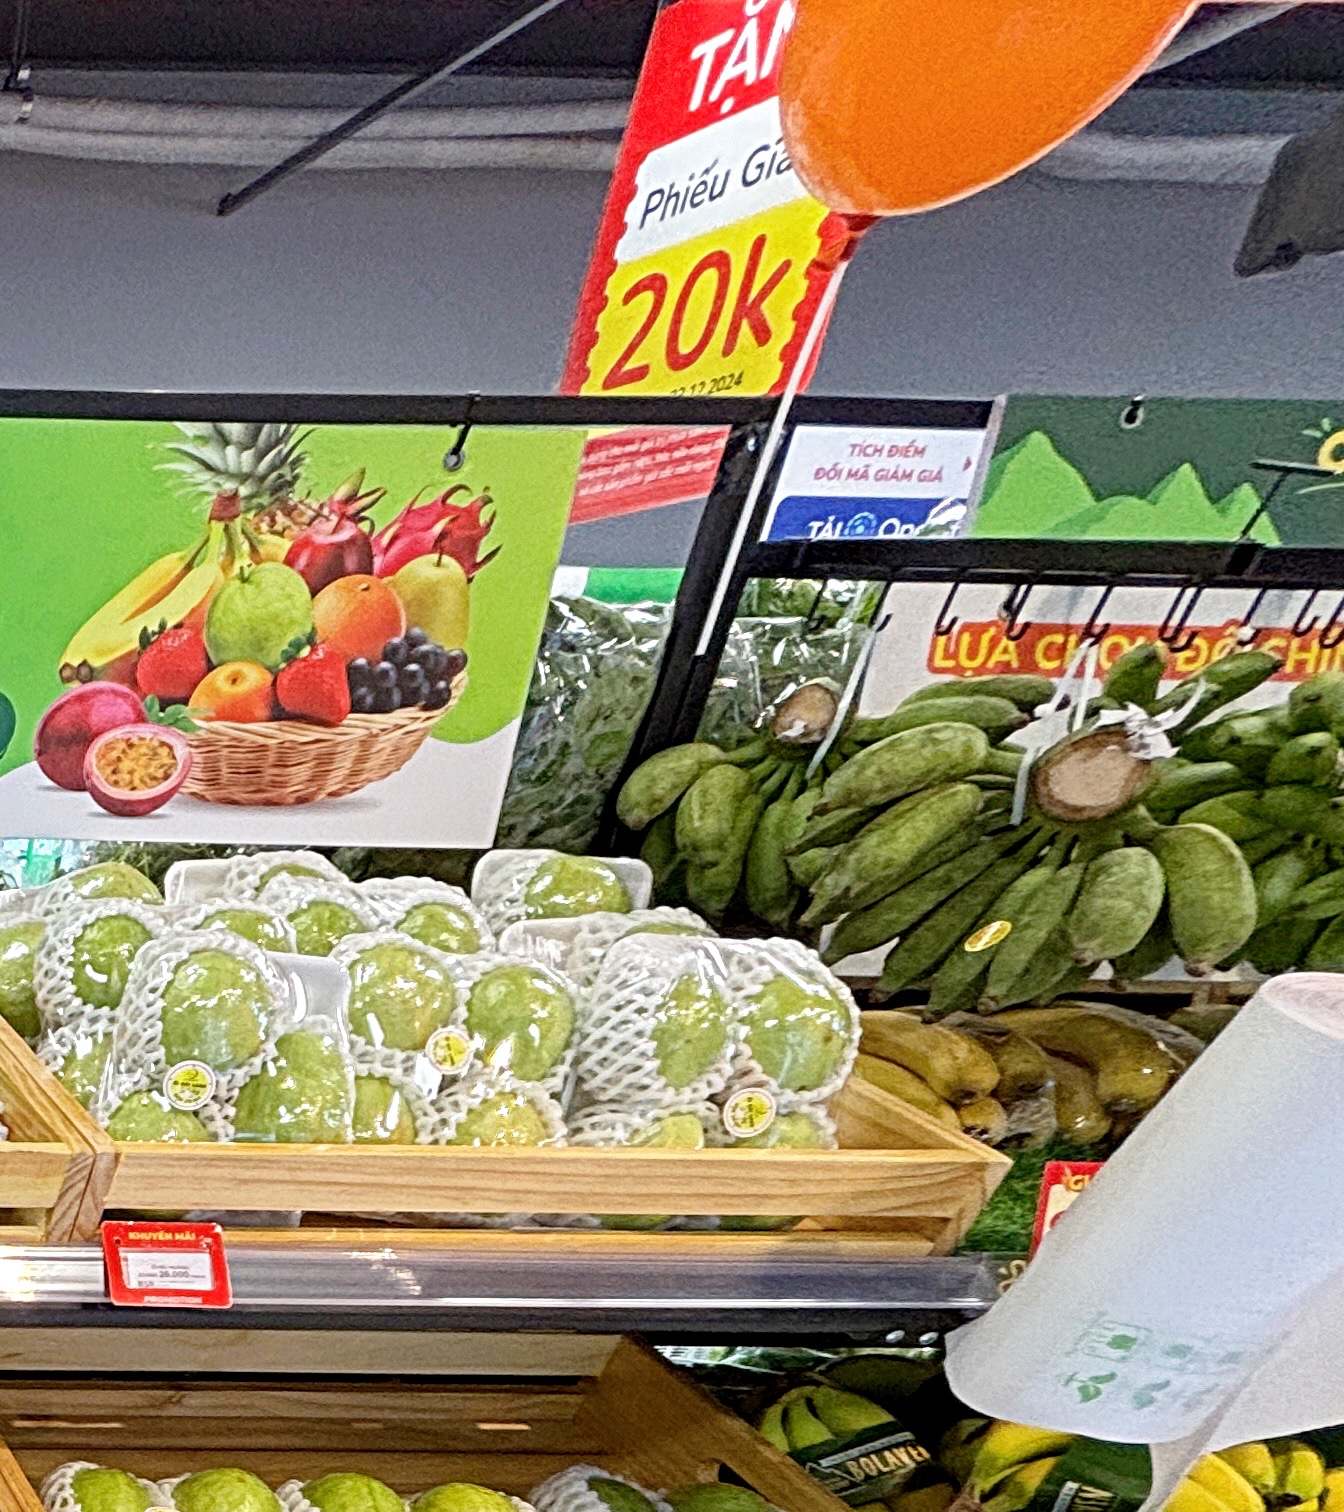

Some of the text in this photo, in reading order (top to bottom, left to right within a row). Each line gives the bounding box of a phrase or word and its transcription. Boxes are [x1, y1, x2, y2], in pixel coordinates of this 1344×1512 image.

[639, 158, 731, 229] Phiếu
[601, 233, 793, 390] 20k
[845, 464, 871, 481] MÃ
[917, 465, 944, 482] GIÁ
[849, 440, 885, 458] TÍCH
[933, 625, 1019, 677] LỰA
